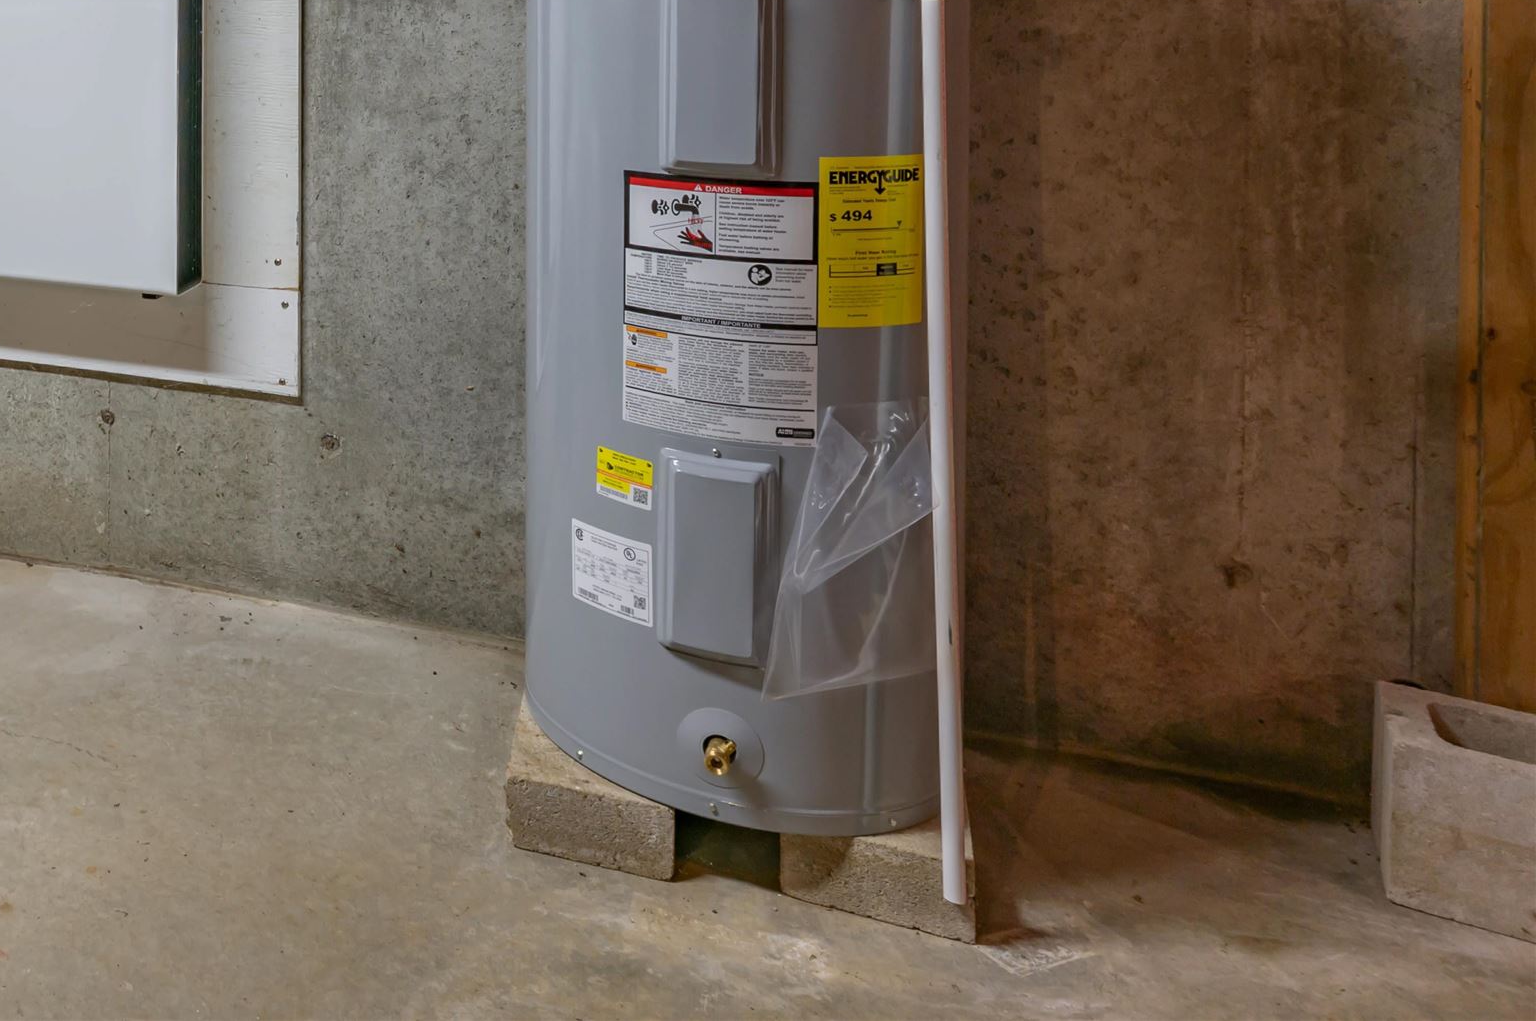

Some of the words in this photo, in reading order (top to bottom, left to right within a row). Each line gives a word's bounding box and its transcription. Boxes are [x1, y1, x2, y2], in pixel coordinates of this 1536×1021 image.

[705, 185, 742, 194] DANGER
[829, 213, 837, 222] $
[841, 210, 872, 221] 494
[681, 315, 716, 324] IMPORTANT
[720, 319, 761, 328] IMPORTANTE
